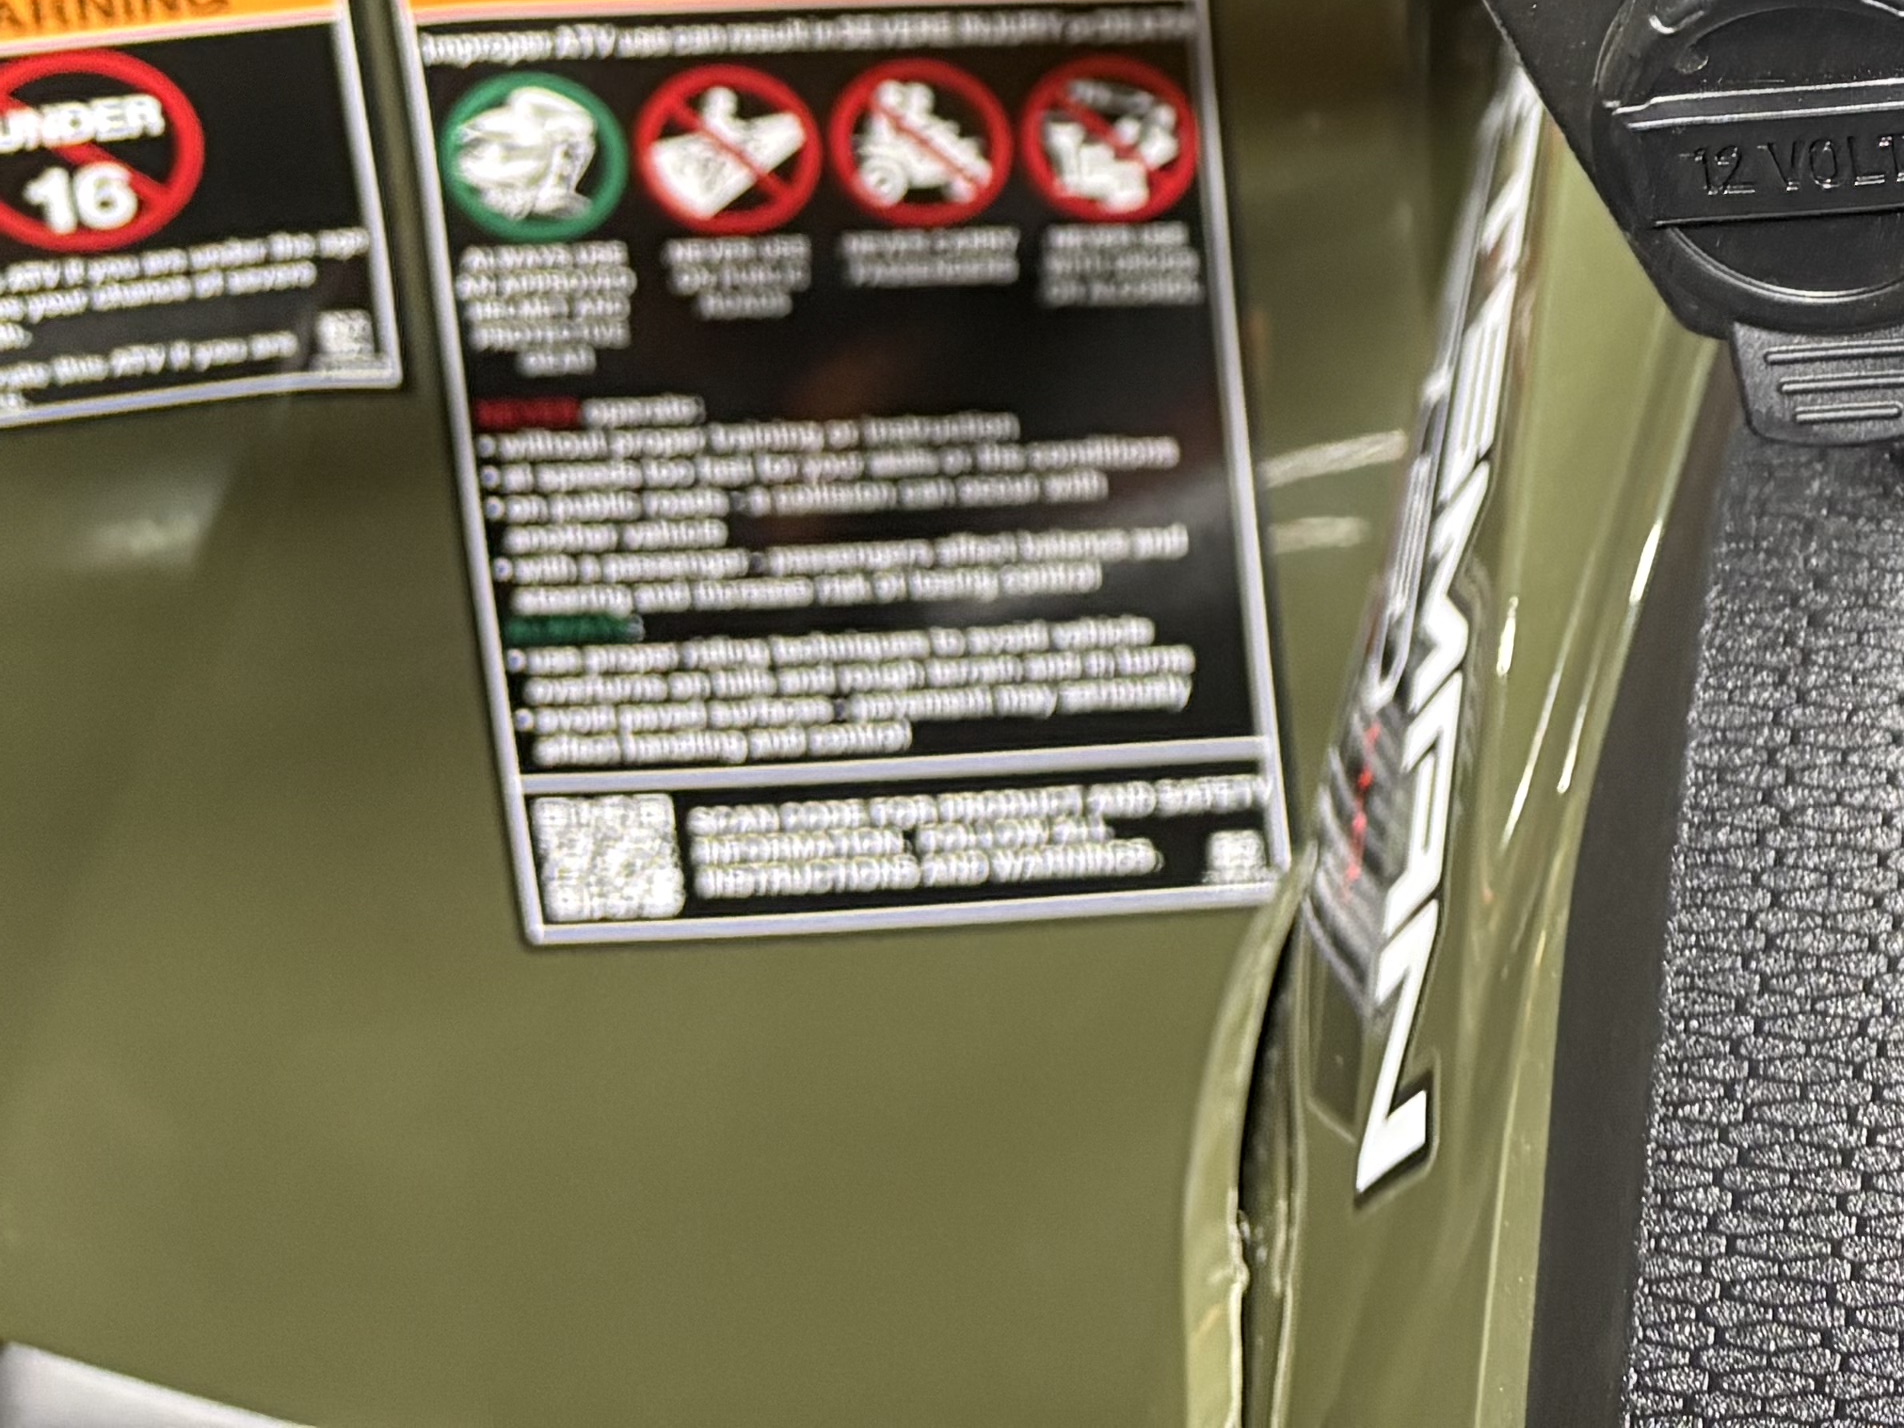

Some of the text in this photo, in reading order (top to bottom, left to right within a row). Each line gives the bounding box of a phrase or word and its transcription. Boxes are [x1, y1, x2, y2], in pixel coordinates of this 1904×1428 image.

[0, 94, 166, 152] UNDER
[24, 160, 138, 235] 16
[1688, 145, 1755, 197] 12
